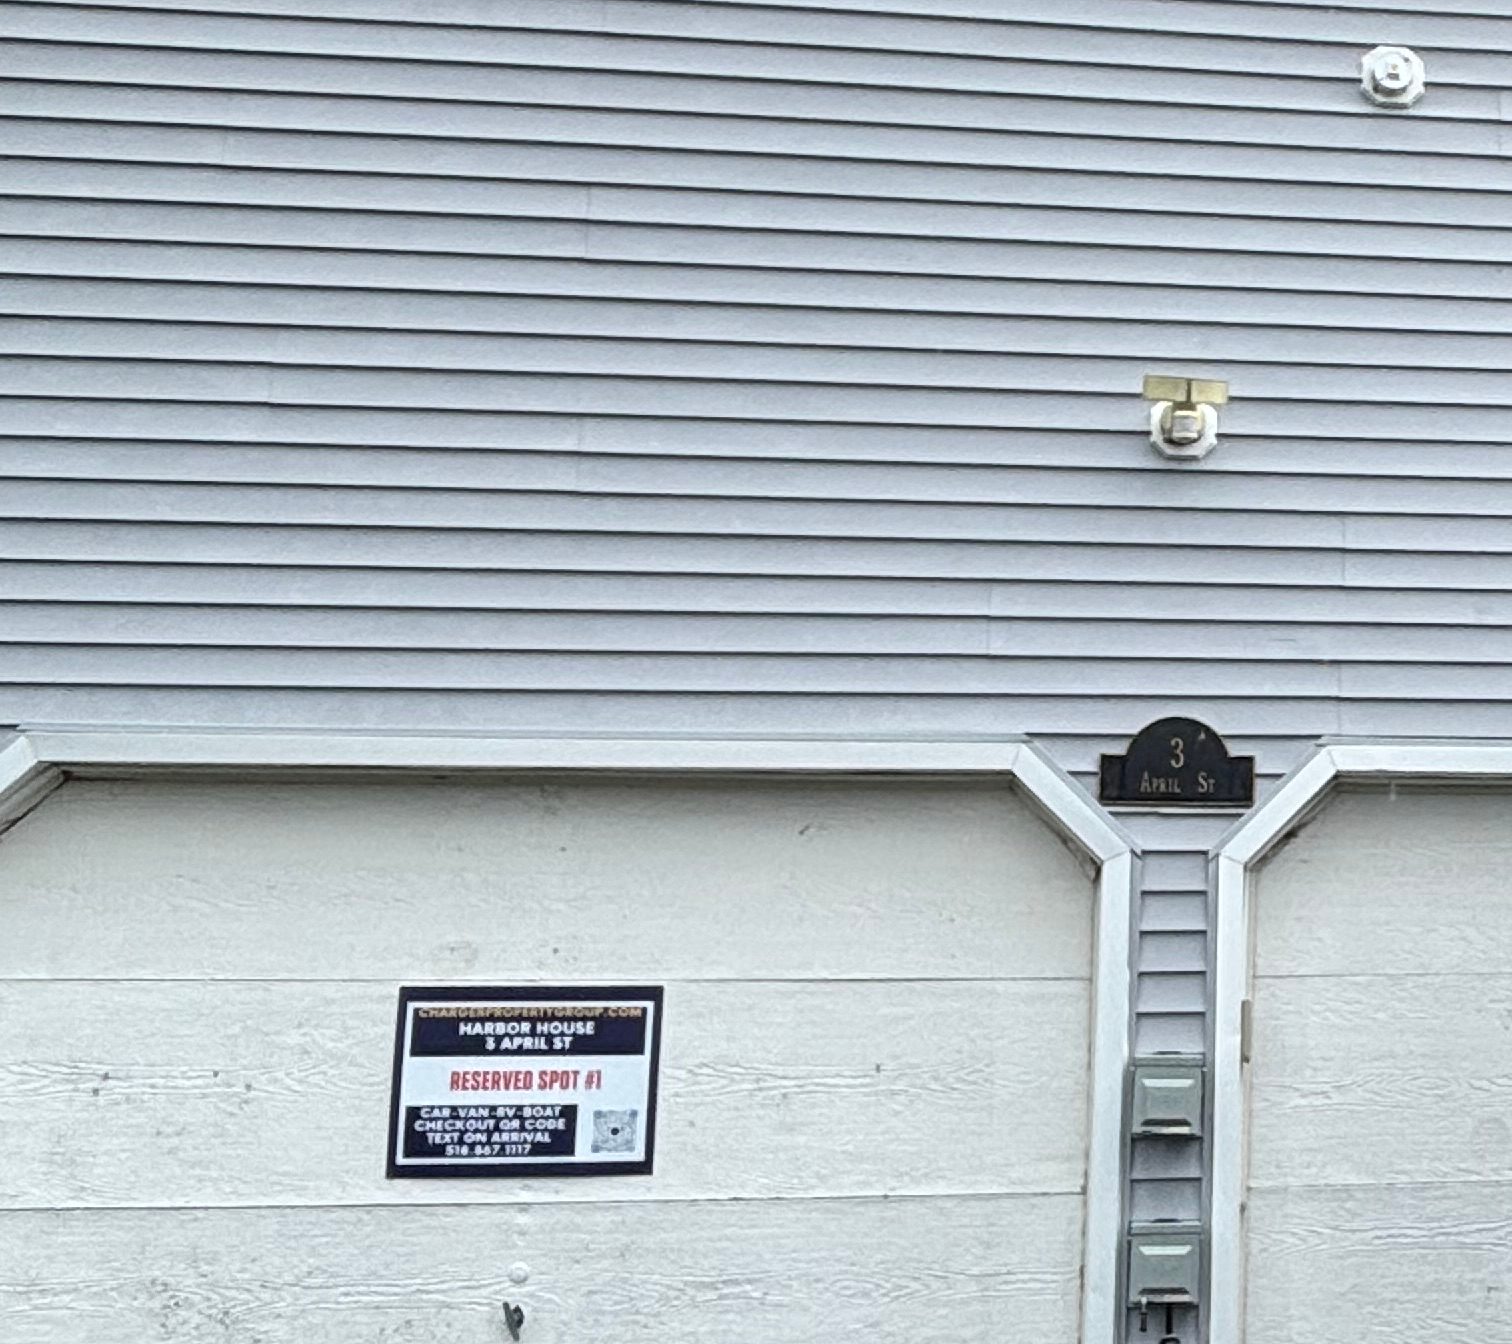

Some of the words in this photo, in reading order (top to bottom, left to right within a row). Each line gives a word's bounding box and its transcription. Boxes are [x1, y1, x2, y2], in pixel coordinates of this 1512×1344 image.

[1170, 737, 1184, 768] 3
[418, 1007, 642, 1018] CHARGERPROPERTYGROUP.COM
[459, 1022, 530, 1036] HARBOR
[536, 1021, 595, 1034] HOUSE
[485, 1038, 495, 1050] 3
[500, 1036, 548, 1050] APRIL
[552, 1036, 573, 1050] ST
[450, 1070, 533, 1091] RESERVED
[537, 1070, 580, 1090] SPOT
[584, 1070, 602, 1090] #1
[414, 1119, 495, 1132] CHECKOUT
[500, 1119, 521, 1131] QR
[524, 1118, 566, 1130] CODE
[427, 1132, 459, 1145] TEXT
[464, 1132, 487, 1144] ON
[490, 1131, 551, 1144] ARRIVAL
